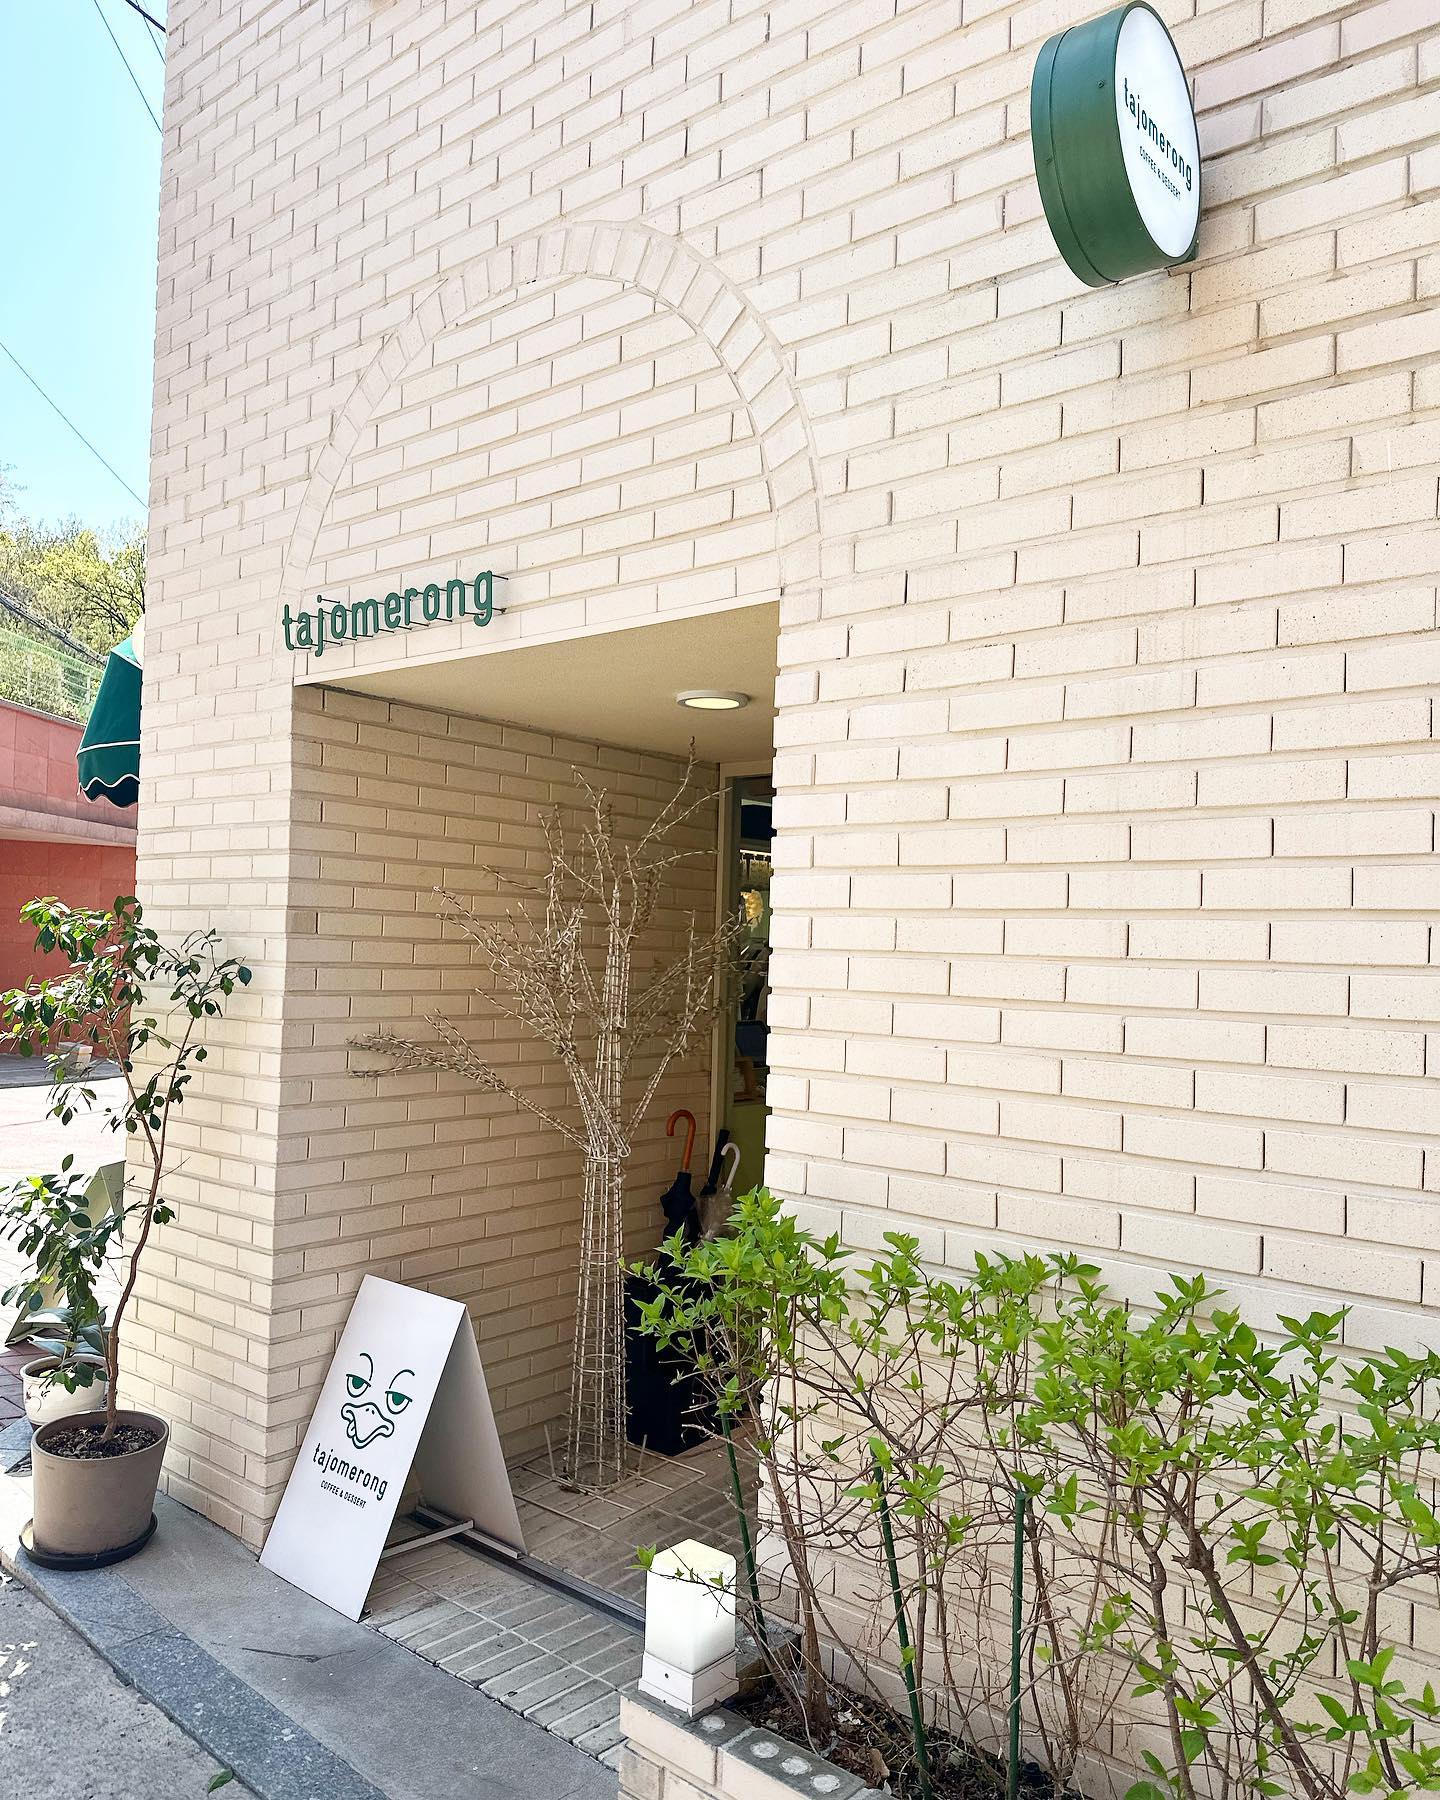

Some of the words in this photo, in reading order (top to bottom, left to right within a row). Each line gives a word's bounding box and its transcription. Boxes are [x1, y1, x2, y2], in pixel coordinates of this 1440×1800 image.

[1124, 78, 1192, 191] tajomerong
[1140, 146, 1157, 173] COFFEE
[1162, 172, 1181, 200] DESSERT
[282, 570, 493, 657] tajomerong
[313, 1442, 388, 1501] tajomerong
[320, 1480, 340, 1495] COFFEE
[344, 1492, 366, 1508] DESSERT
